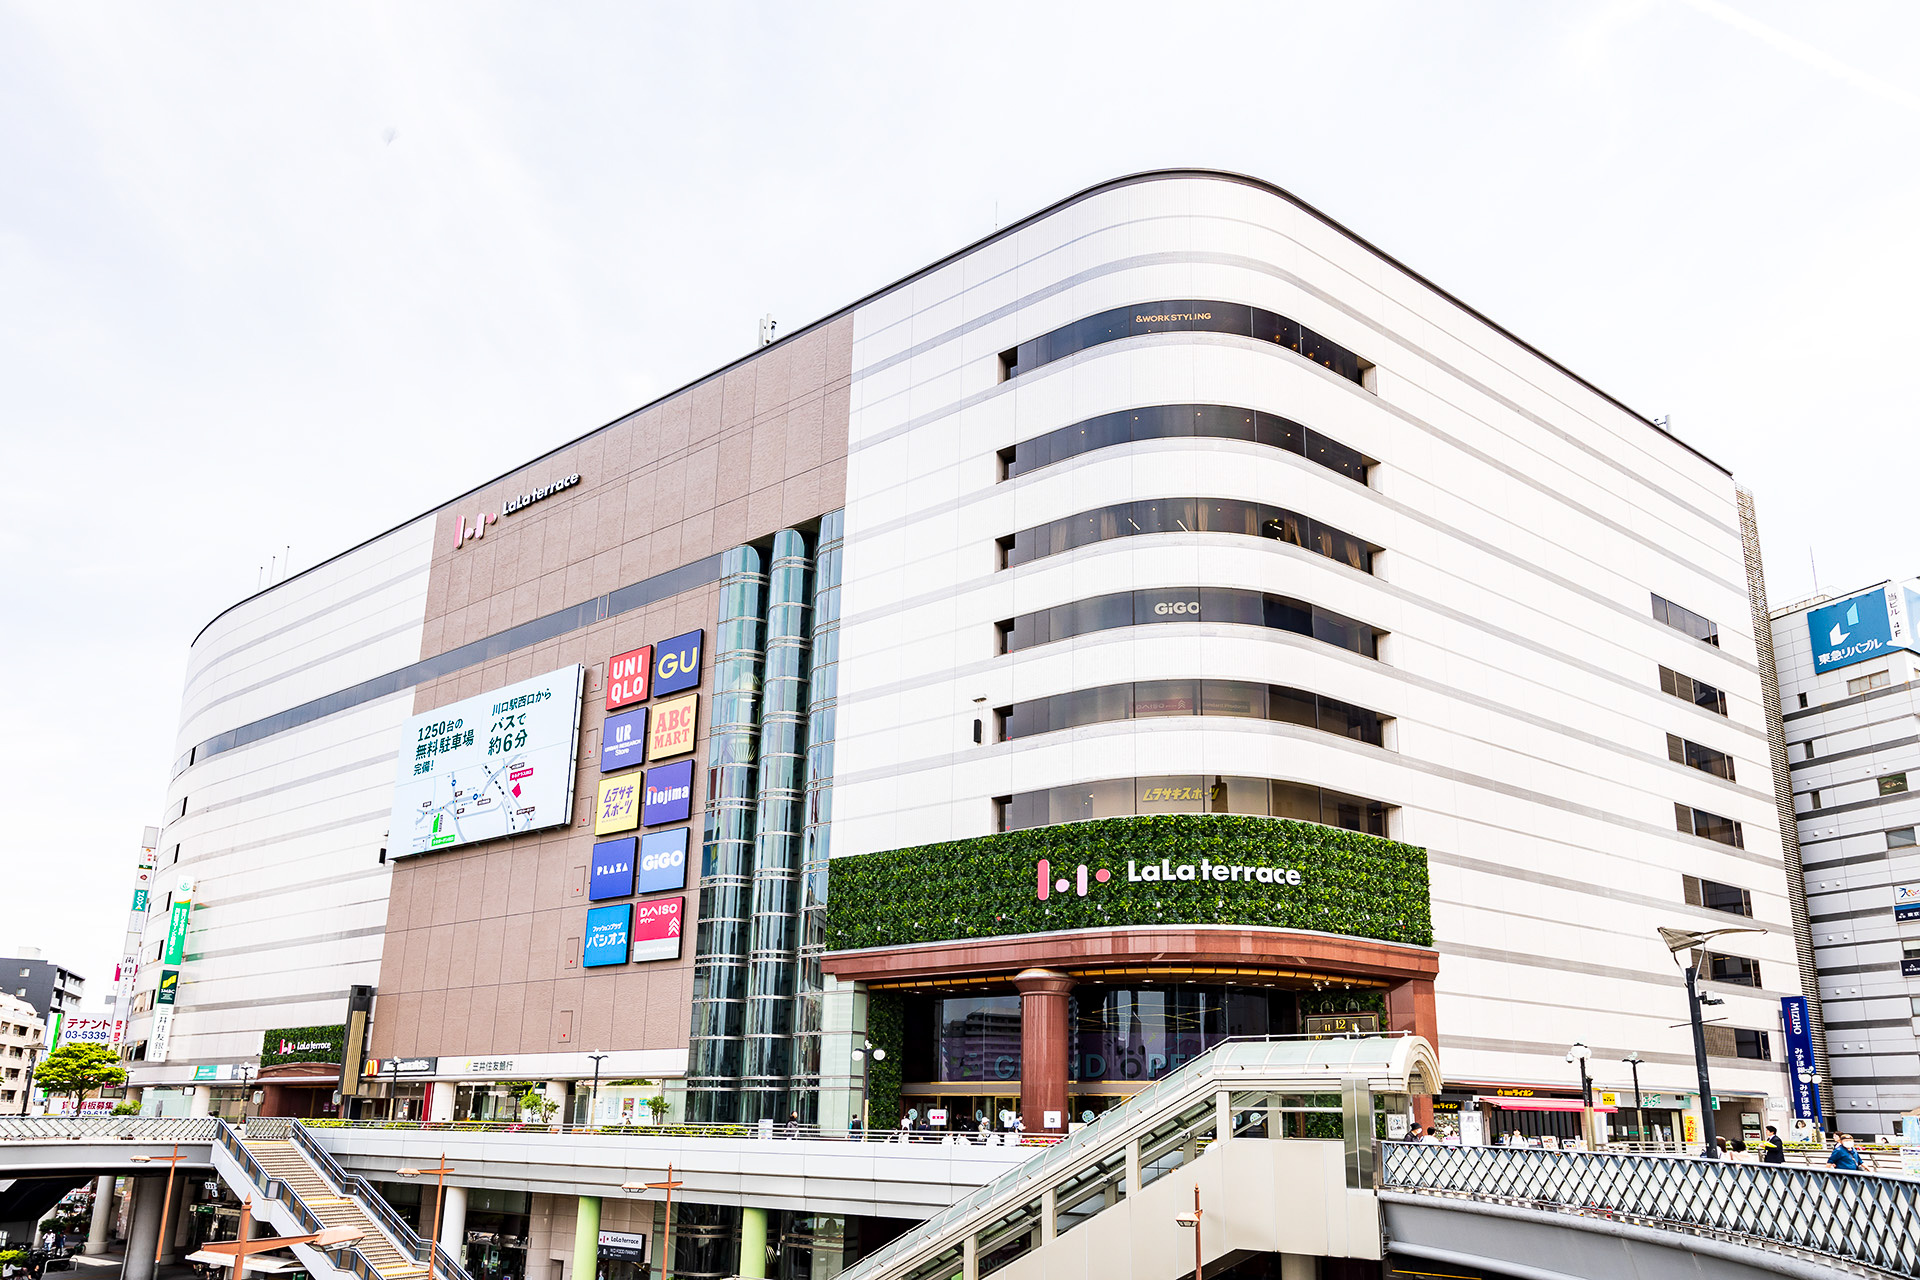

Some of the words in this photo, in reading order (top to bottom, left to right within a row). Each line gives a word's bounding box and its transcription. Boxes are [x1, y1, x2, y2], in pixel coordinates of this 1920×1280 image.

[502, 495, 531, 516] LaLa
[530, 473, 581, 502] terrace
[1154, 601, 1202, 615] GiGO
[657, 646, 698, 679] GU
[1817, 638, 1884, 666] 東急リバブル
[612, 654, 643, 680] UNI
[611, 676, 644, 704] QLO
[491, 687, 552, 717] 川口駅西口から
[417, 718, 464, 742] 1250台の
[490, 712, 527, 733] バスで
[655, 705, 692, 735] ABC
[415, 728, 475, 761] 無料駐車場
[487, 728, 528, 756] 約6分
[615, 724, 632, 743] UR
[653, 728, 691, 750] MART
[604, 784, 635, 805] ムラサキ
[645, 785, 690, 808] nojima
[602, 799, 633, 820] スポーツ
[596, 862, 629, 876] PLAZA
[642, 849, 684, 872] GiGO
[1127, 858, 1195, 882] LaLa
[1200, 858, 1301, 886] terrace
[639, 903, 679, 919] DAISO
[586, 931, 627, 949] パシオス
[67, 1018, 111, 1031] テナント
[1335, 1018, 1346, 1030] 12
[1789, 1002, 1803, 1036] MIZUHO
[472, 1060, 514, 1072] 三井住友銀行
